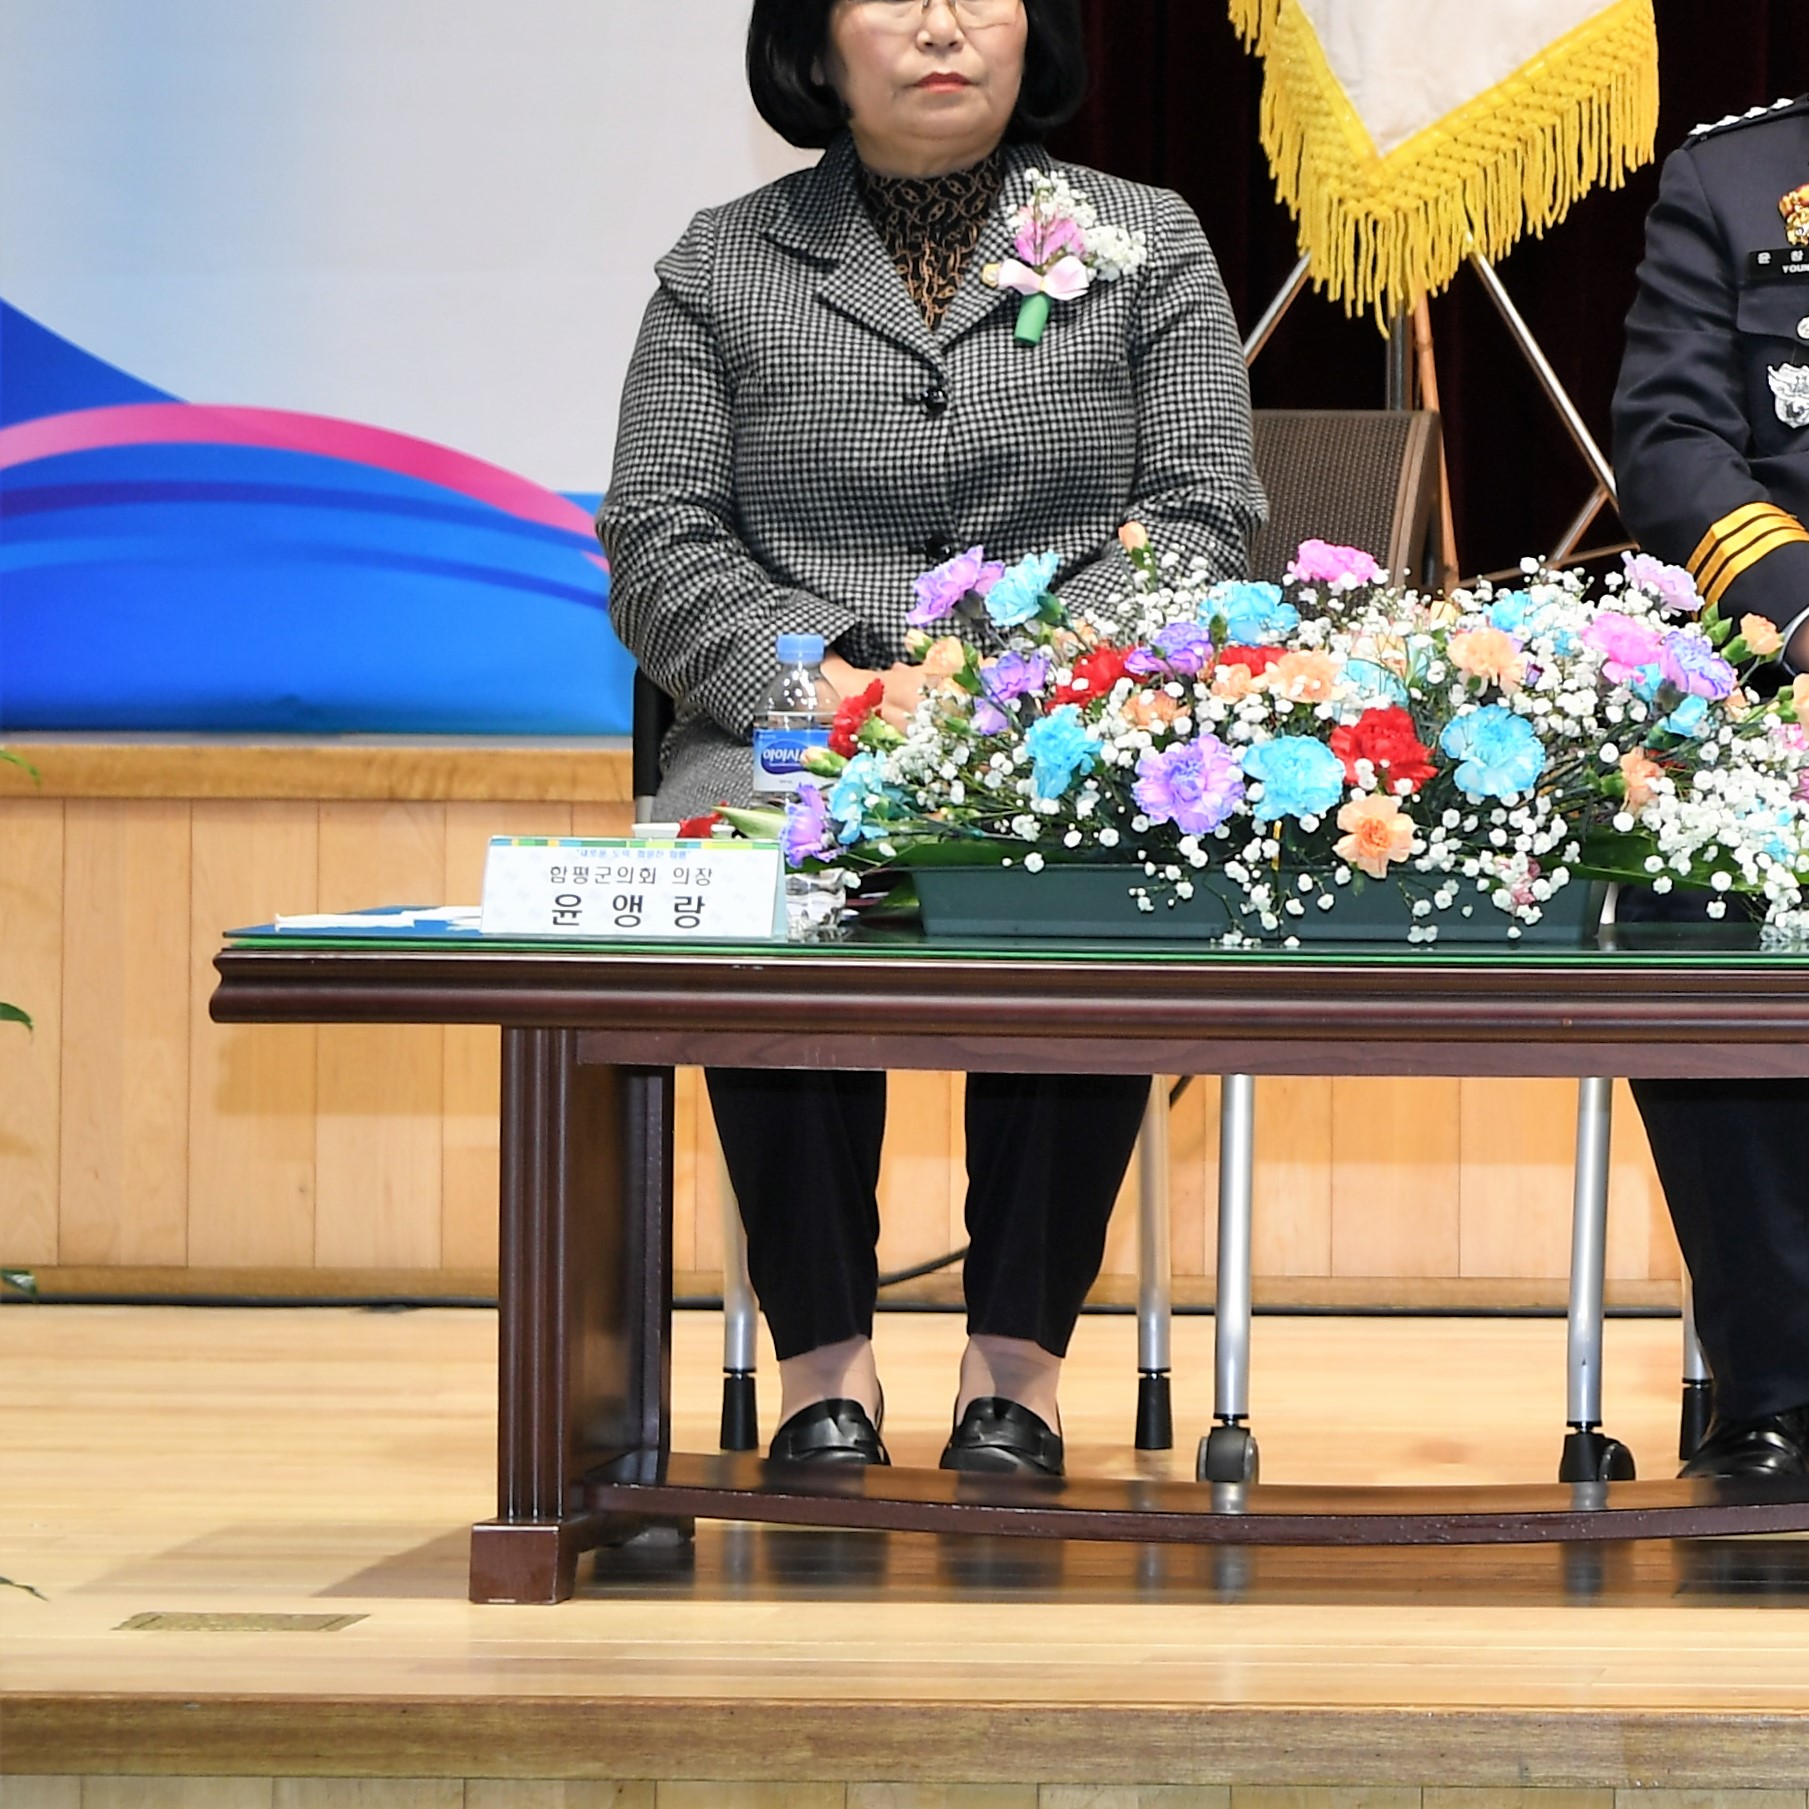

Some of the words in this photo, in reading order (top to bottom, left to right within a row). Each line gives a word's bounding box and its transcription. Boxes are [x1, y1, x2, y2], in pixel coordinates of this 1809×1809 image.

[762, 748, 802, 762] 아이시
[550, 865, 657, 886] 함평군의회
[671, 867, 713, 887] 의장
